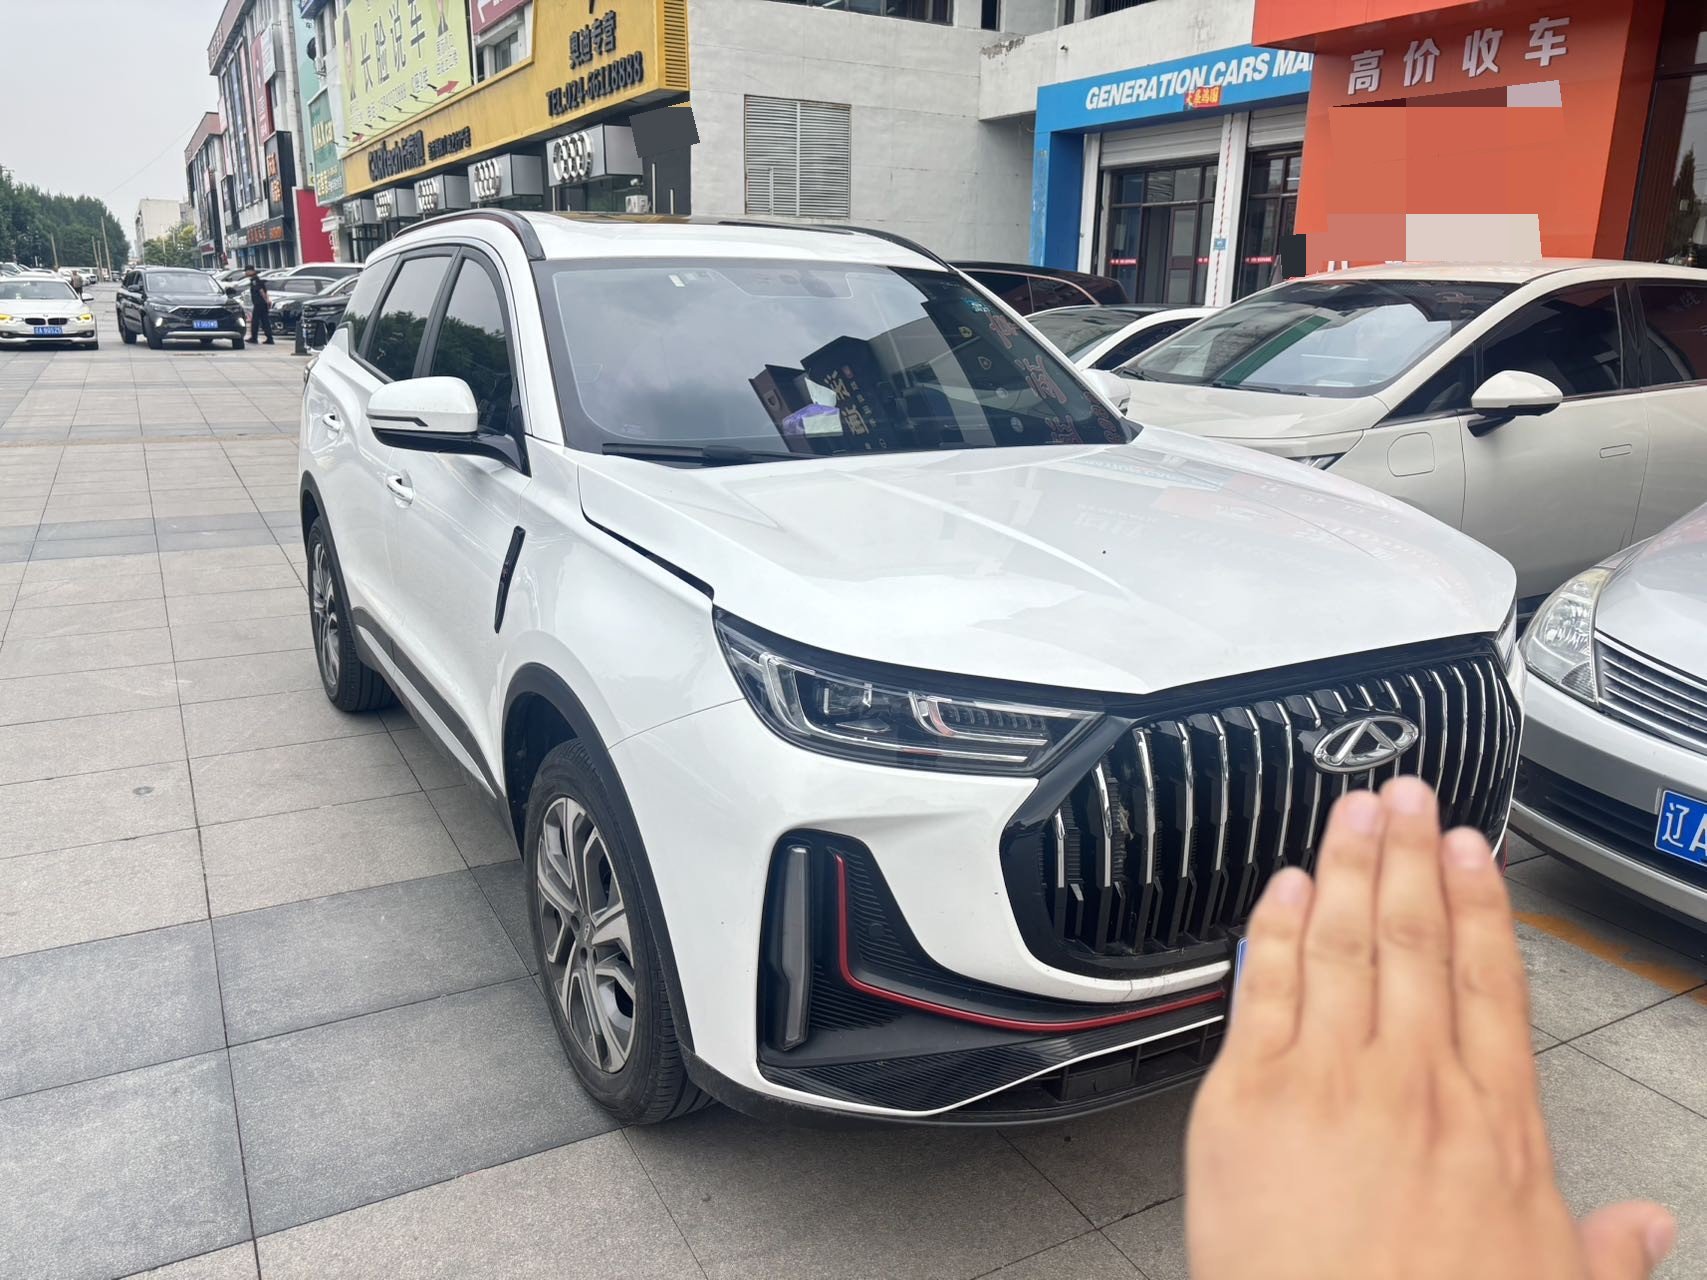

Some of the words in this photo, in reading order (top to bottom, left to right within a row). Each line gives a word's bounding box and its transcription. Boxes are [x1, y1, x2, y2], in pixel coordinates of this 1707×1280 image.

[569, 10, 617, 70] 奥迪专营
[1347, 16, 1570, 95] 高价收车
[1085, 65, 1207, 110] GENERATION
[1209, 52, 1270, 87] CARS
[1272, 50, 1314, 78] MA
